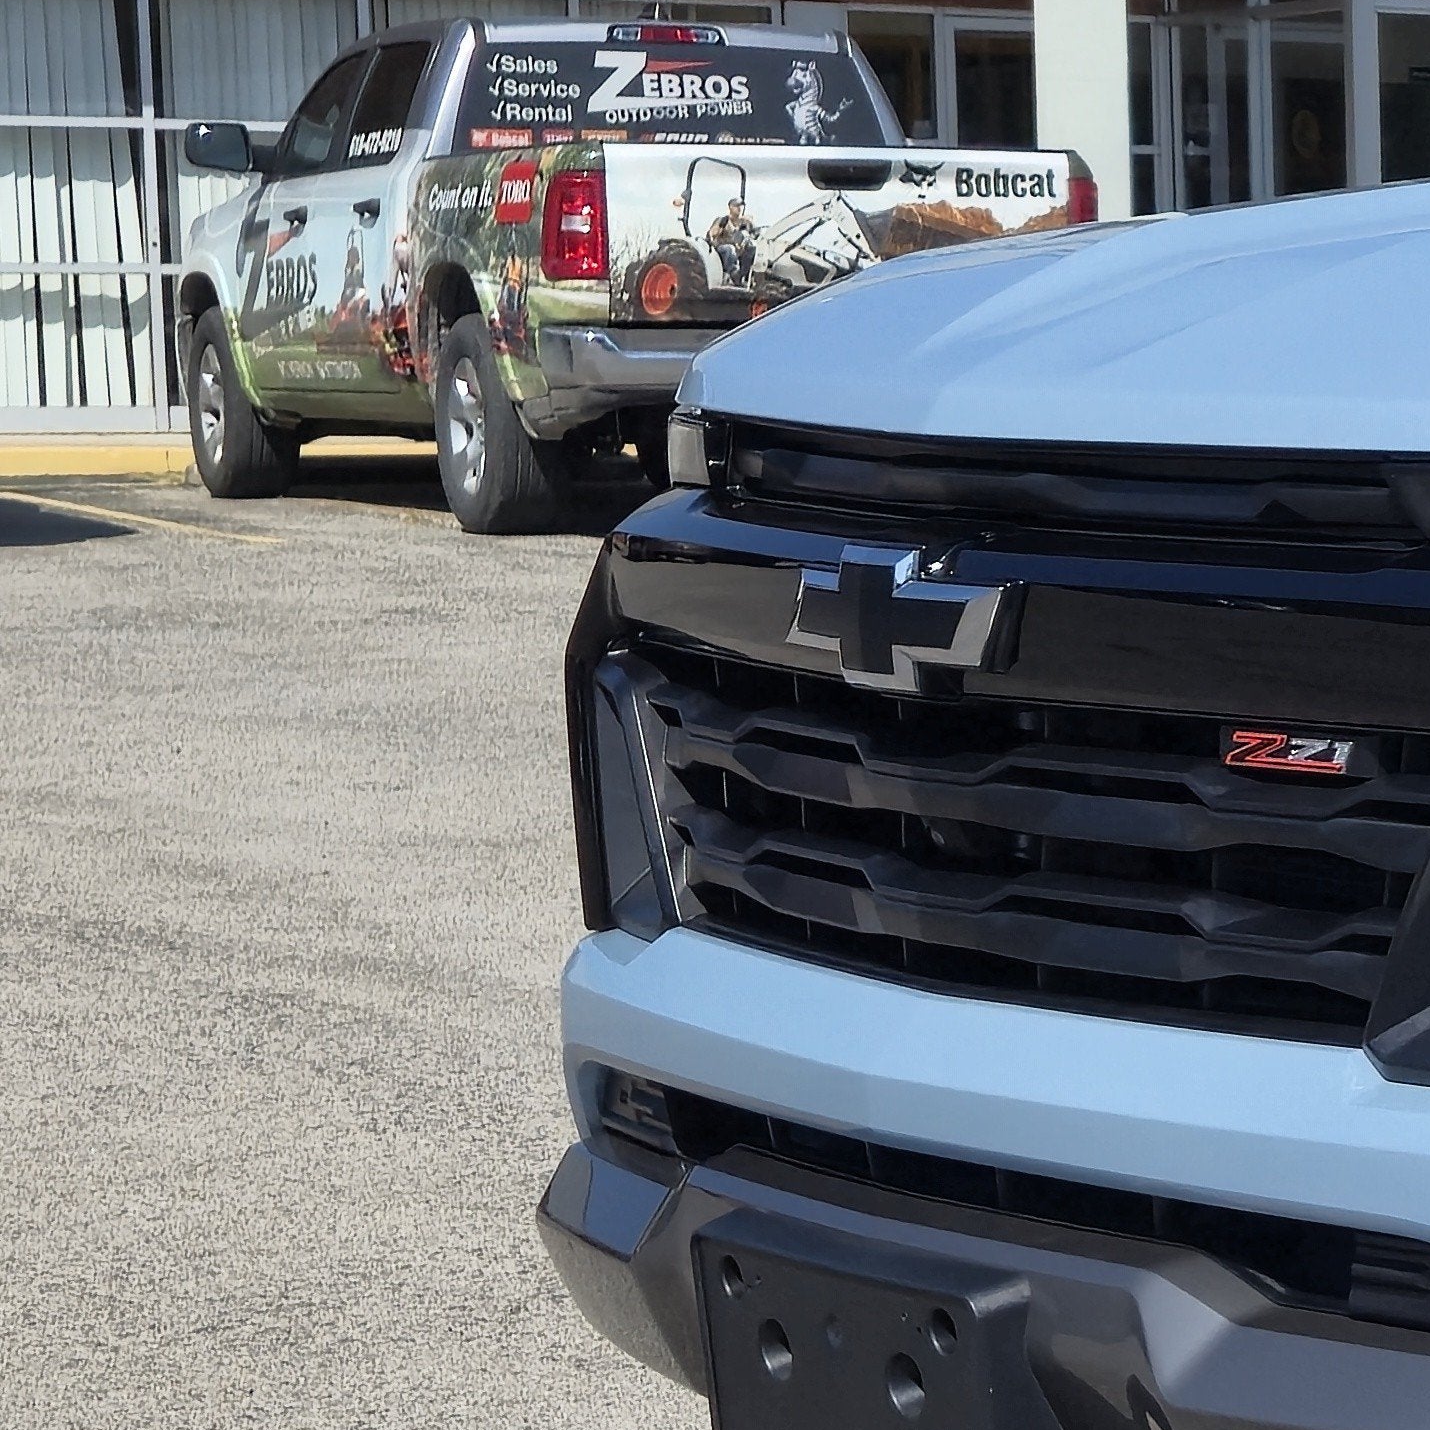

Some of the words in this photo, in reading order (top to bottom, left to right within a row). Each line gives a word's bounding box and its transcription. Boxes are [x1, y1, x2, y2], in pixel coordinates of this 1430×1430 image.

[500, 54, 558, 75] Sales
[503, 79, 581, 99] Service
[586, 50, 750, 113] ZEBROS
[506, 103, 573, 122] Rental
[605, 102, 690, 125] OUTDOOR
[696, 99, 753, 119] POWER
[501, 178, 531, 203] TORO
[955, 167, 1056, 198] Bobcat
[429, 182, 462, 211] Count
[461, 188, 479, 209] on
[1223, 730, 1354, 774] Z71
